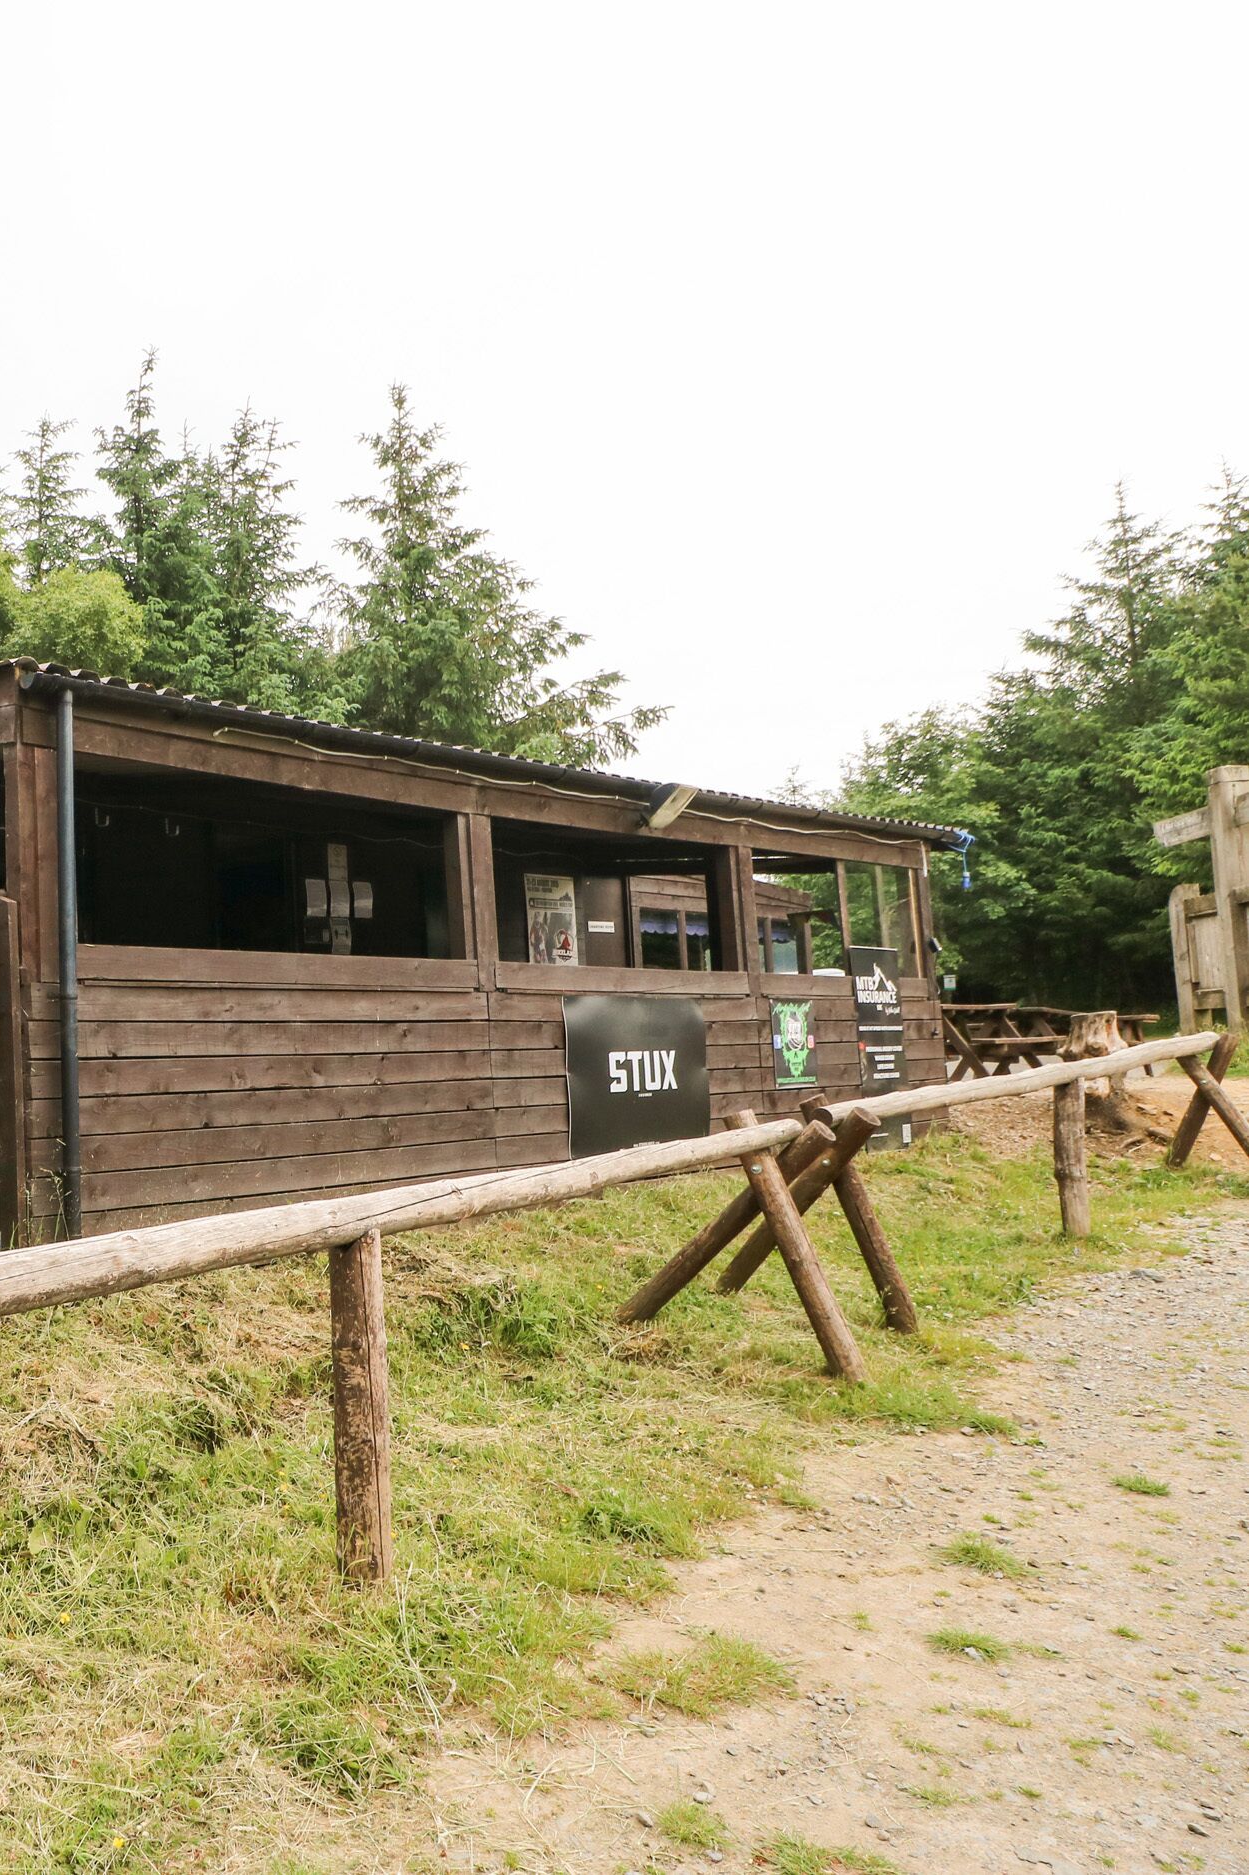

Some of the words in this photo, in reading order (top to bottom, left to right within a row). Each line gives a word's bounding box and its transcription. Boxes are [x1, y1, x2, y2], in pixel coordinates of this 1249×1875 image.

[855, 976, 873, 991] MTB
[857, 990, 898, 1004] INSURANCE
[608, 1050, 679, 1093] STUX
